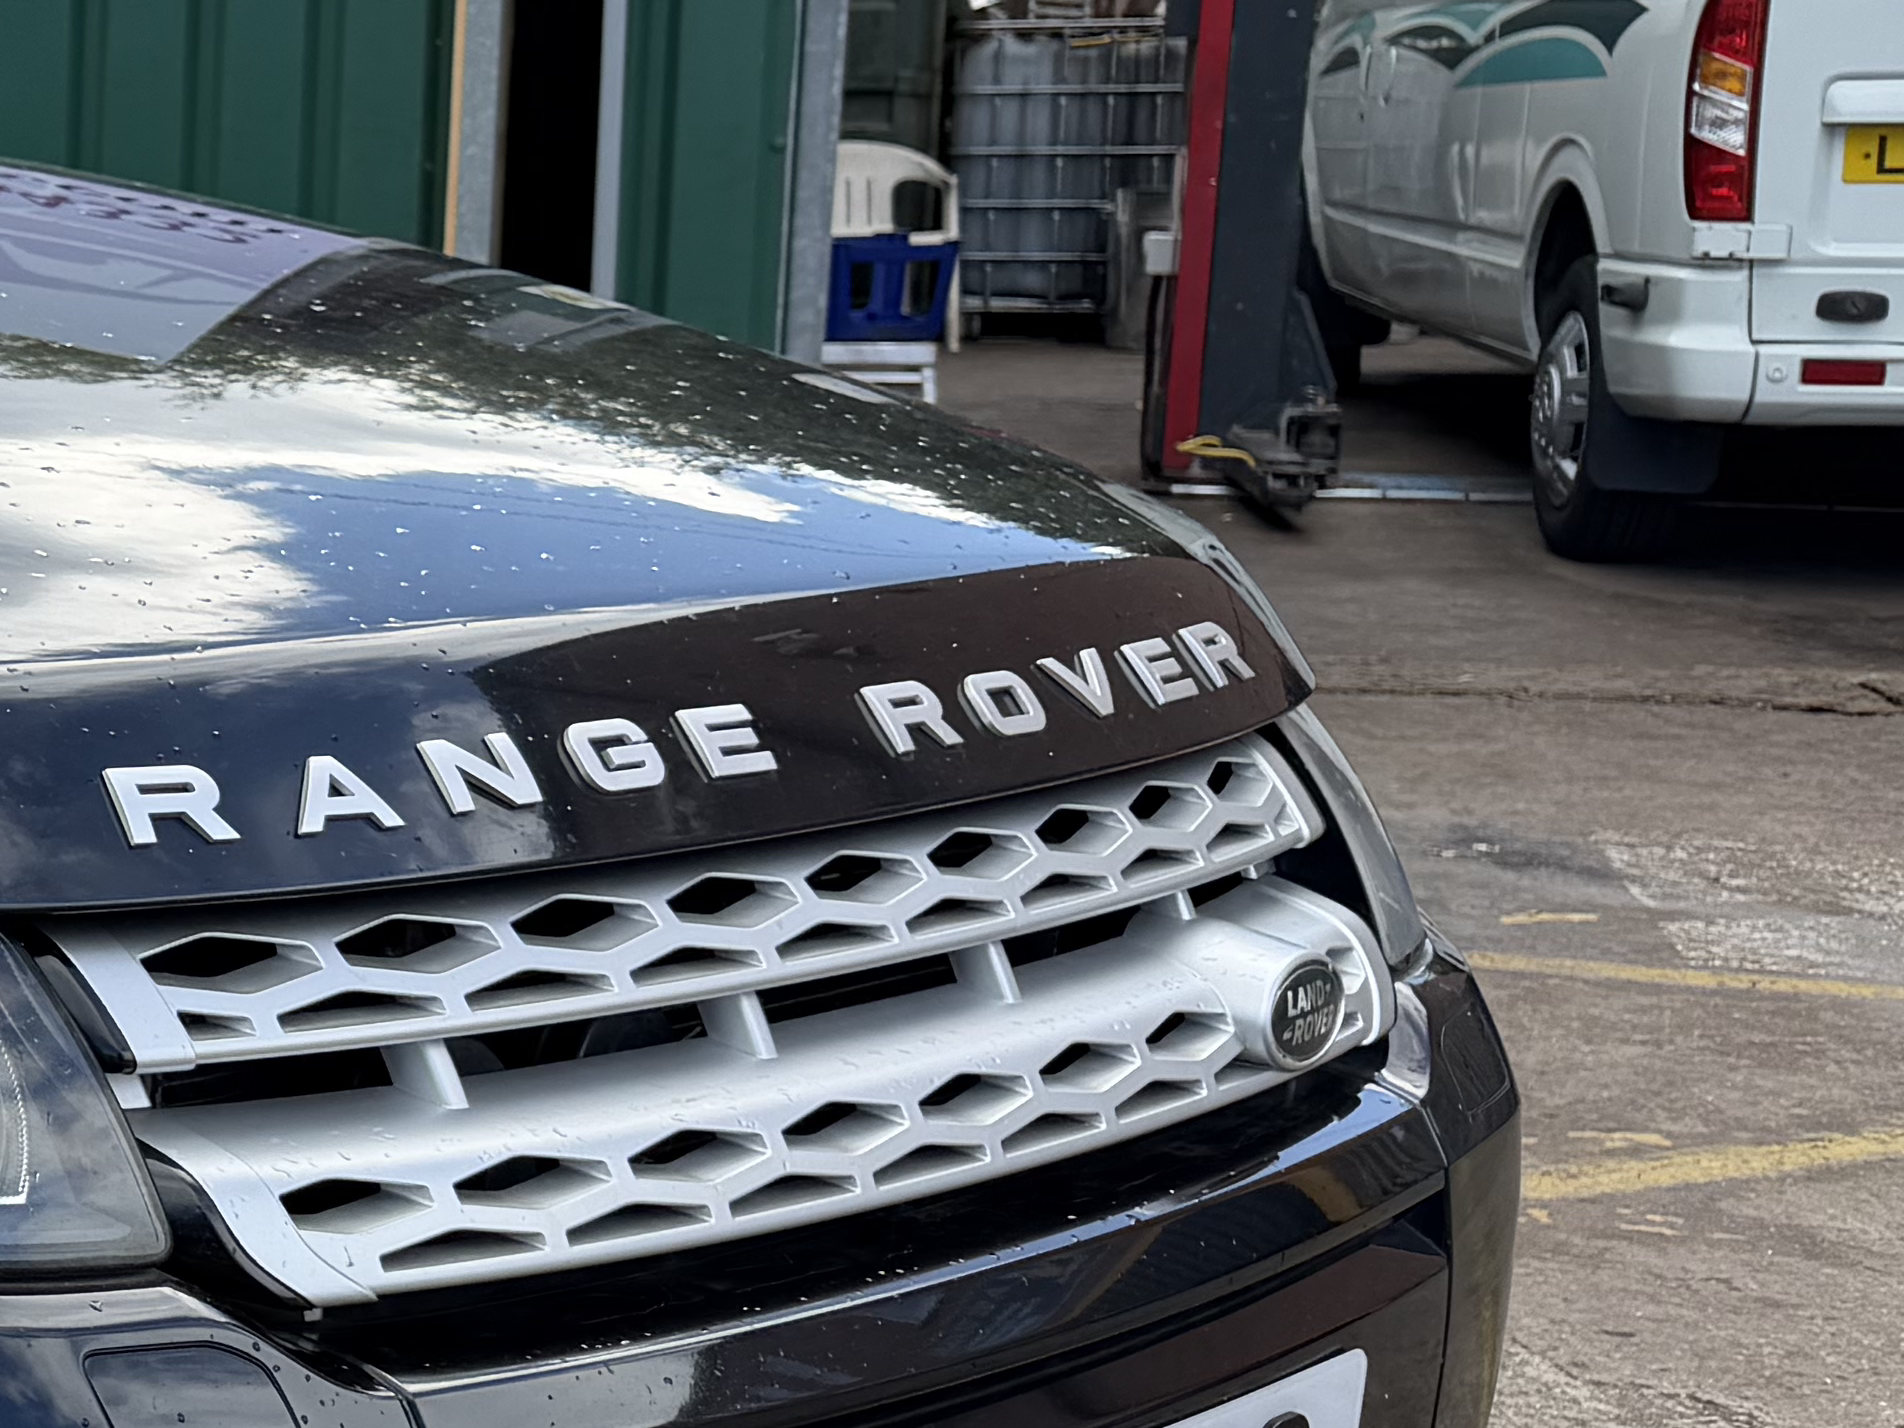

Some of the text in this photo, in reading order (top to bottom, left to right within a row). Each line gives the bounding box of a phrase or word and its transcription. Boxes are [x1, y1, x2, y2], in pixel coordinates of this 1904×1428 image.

[102, 619, 1258, 849] RANGE ROVER
[1286, 979, 1326, 1018] LAND
[1290, 1003, 1335, 1046] ROVER
